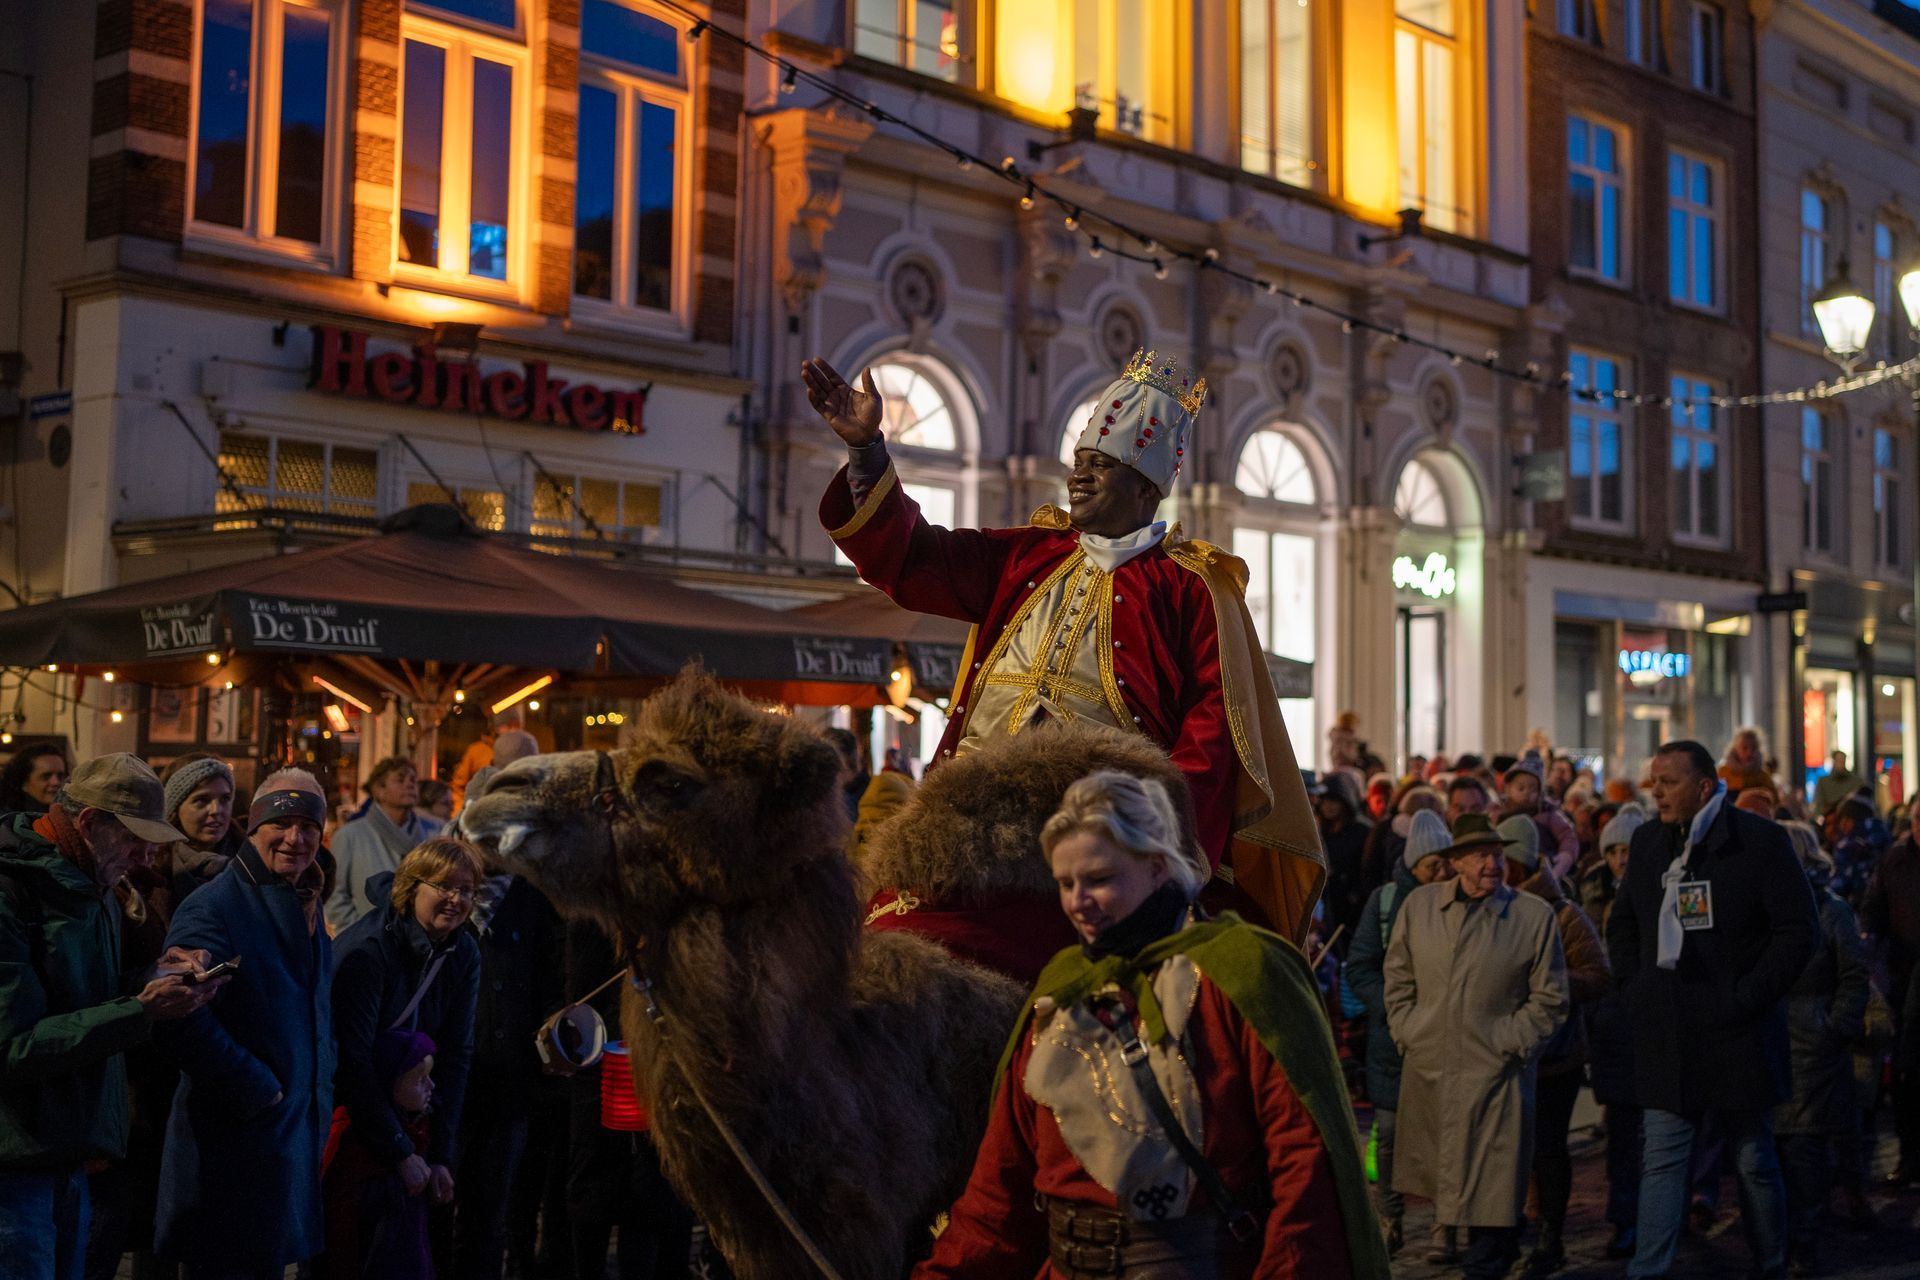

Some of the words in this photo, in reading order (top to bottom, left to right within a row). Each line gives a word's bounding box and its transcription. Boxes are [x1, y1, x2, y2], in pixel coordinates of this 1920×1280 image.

[312, 326, 648, 436] Heineken
[144, 622, 169, 650] De
[172, 613, 214, 648] Druif
[250, 612, 296, 640] De
[304, 615, 379, 646] Druif
[796, 650, 827, 674] De
[830, 650, 881, 676] Druif
